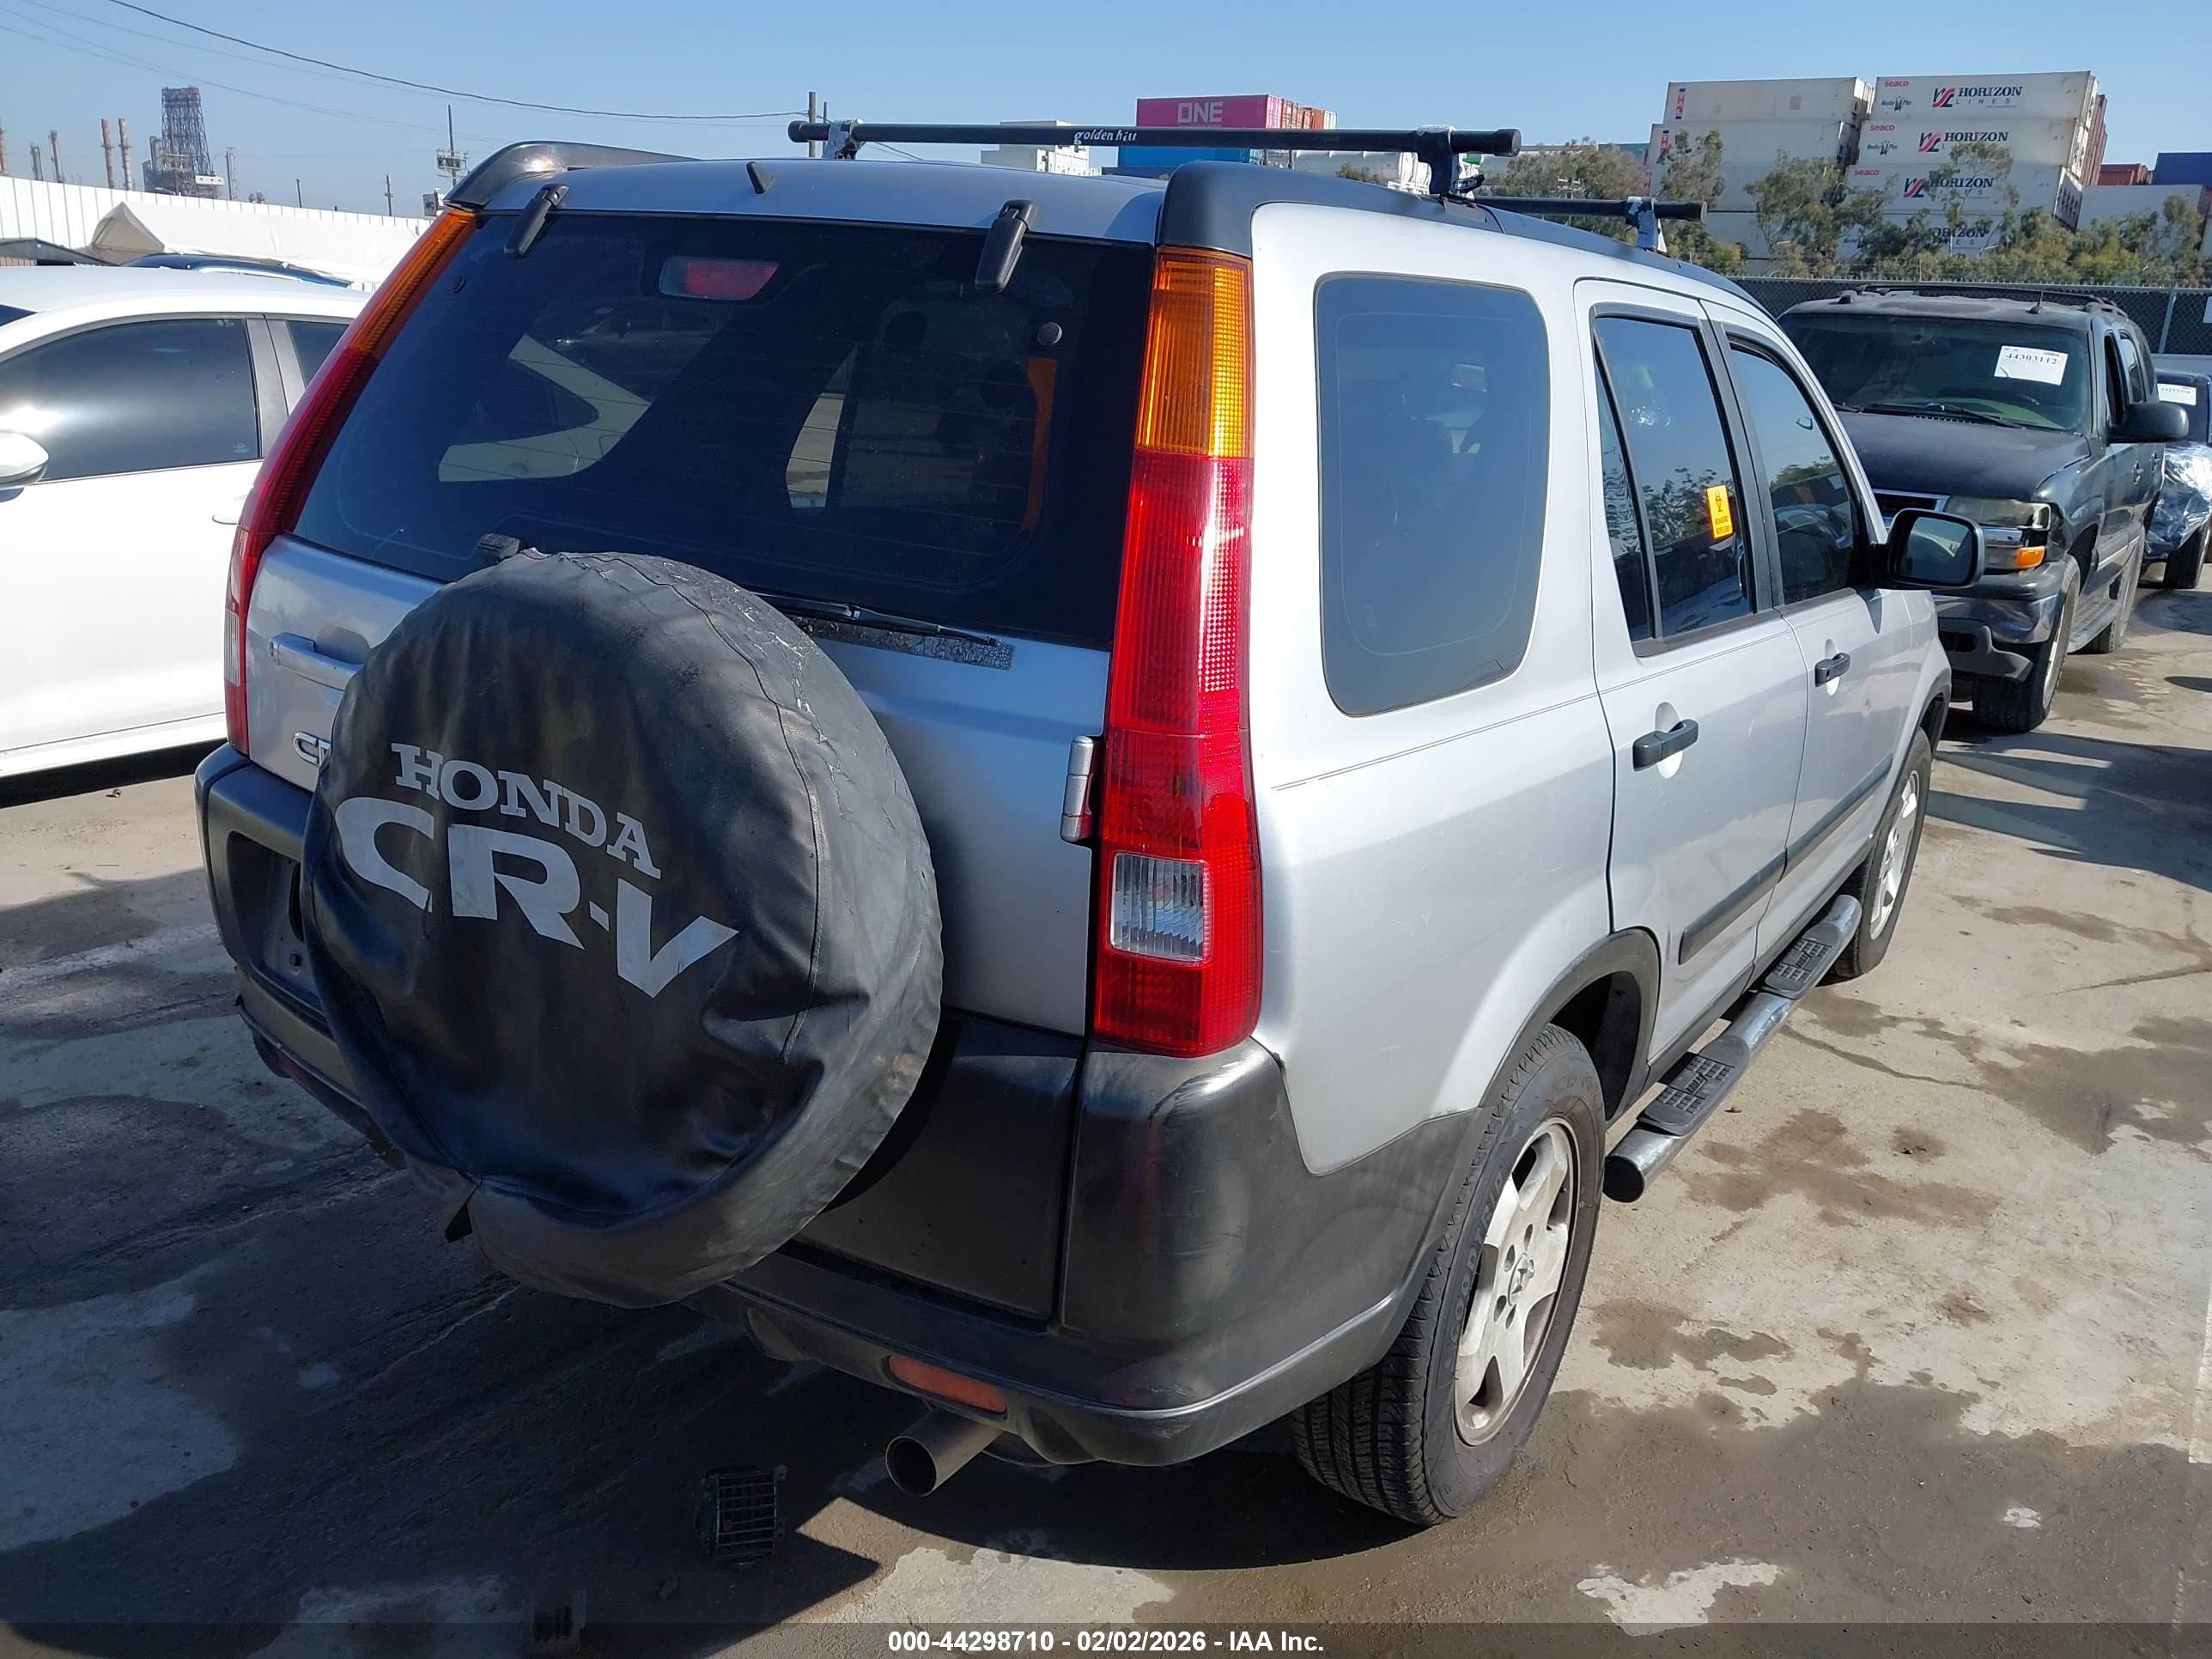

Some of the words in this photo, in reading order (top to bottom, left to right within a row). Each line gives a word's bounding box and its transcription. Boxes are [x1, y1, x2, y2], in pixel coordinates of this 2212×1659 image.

[1958, 86, 2023, 98] HORIZON
[1177, 101, 1224, 123] ONE
[1073, 129, 1113, 145] golden
[1943, 131, 2009, 143] HORIZON
[391, 742, 661, 879] HONDA
[335, 797, 739, 999] CR-V
